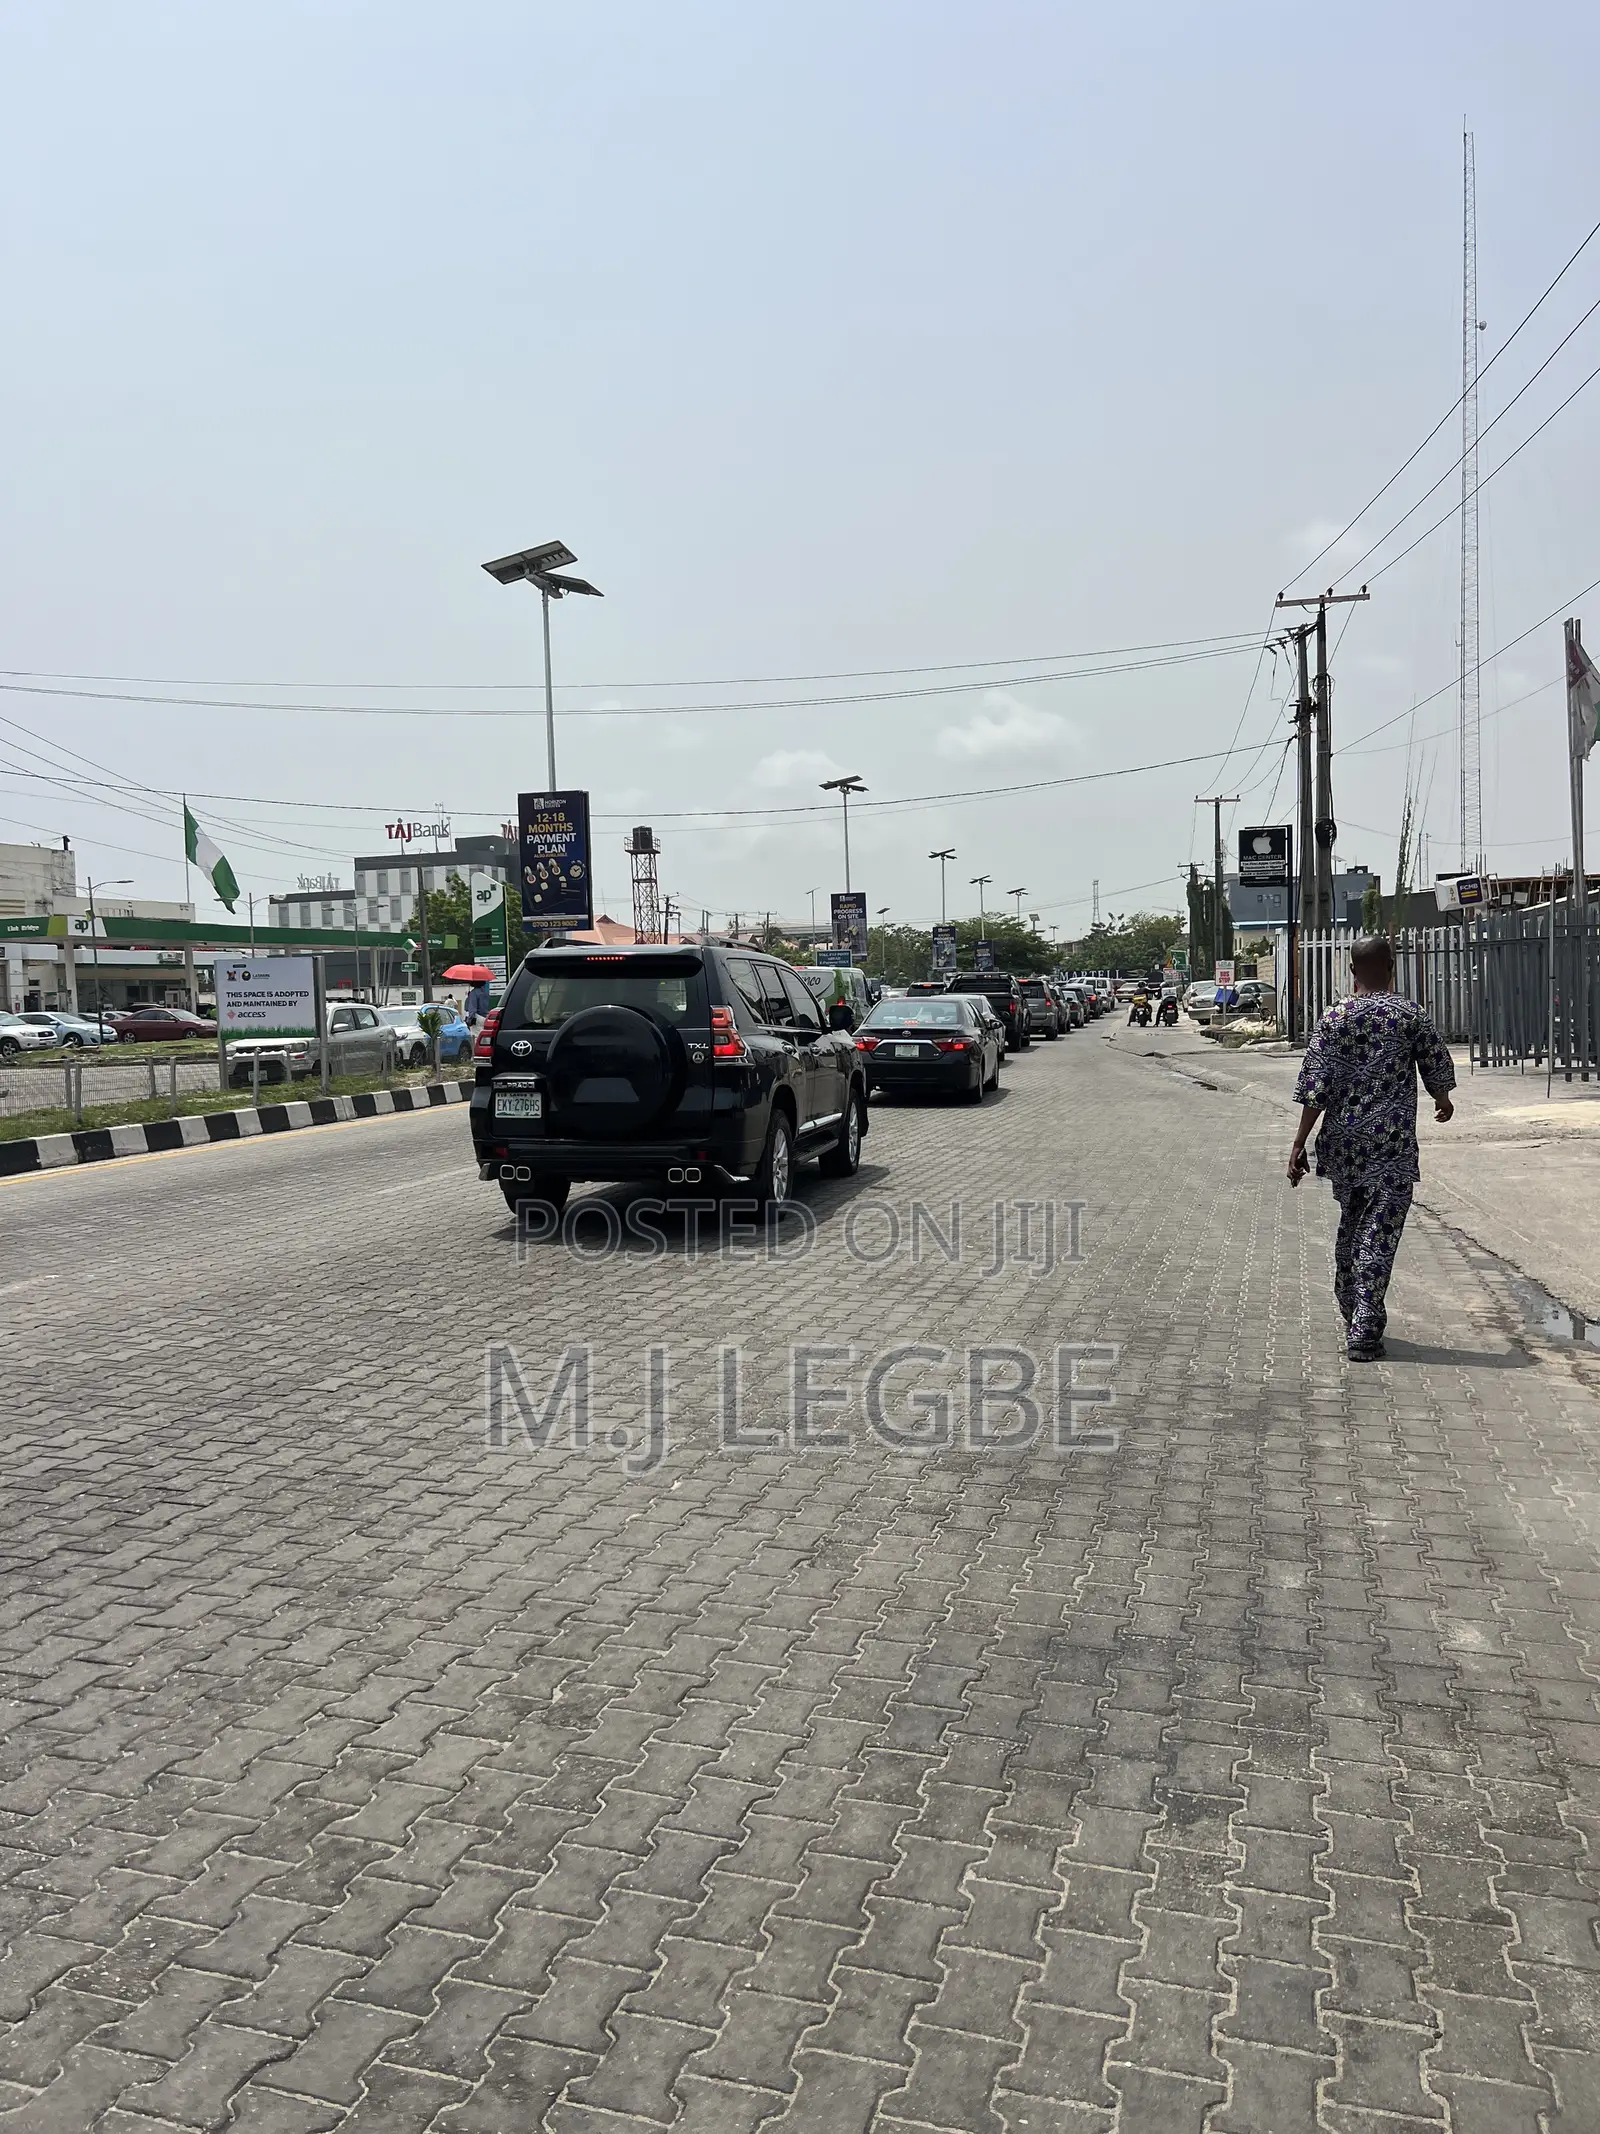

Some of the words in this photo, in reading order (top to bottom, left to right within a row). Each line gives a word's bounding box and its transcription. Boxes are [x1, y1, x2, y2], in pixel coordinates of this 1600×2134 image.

[536, 812, 566, 823] 12-18
[385, 818, 450, 842] TAJBank
[528, 822, 574, 834] MONTHS
[526, 832, 577, 844] PAYMENT
[537, 843, 566, 854] PLAN
[1459, 883, 1479, 891] FCMB
[476, 890, 492, 903] ap
[74, 919, 89, 933] ap
[1060, 969, 1122, 981] MARTELL
[274, 990, 310, 998] ADOPTED
